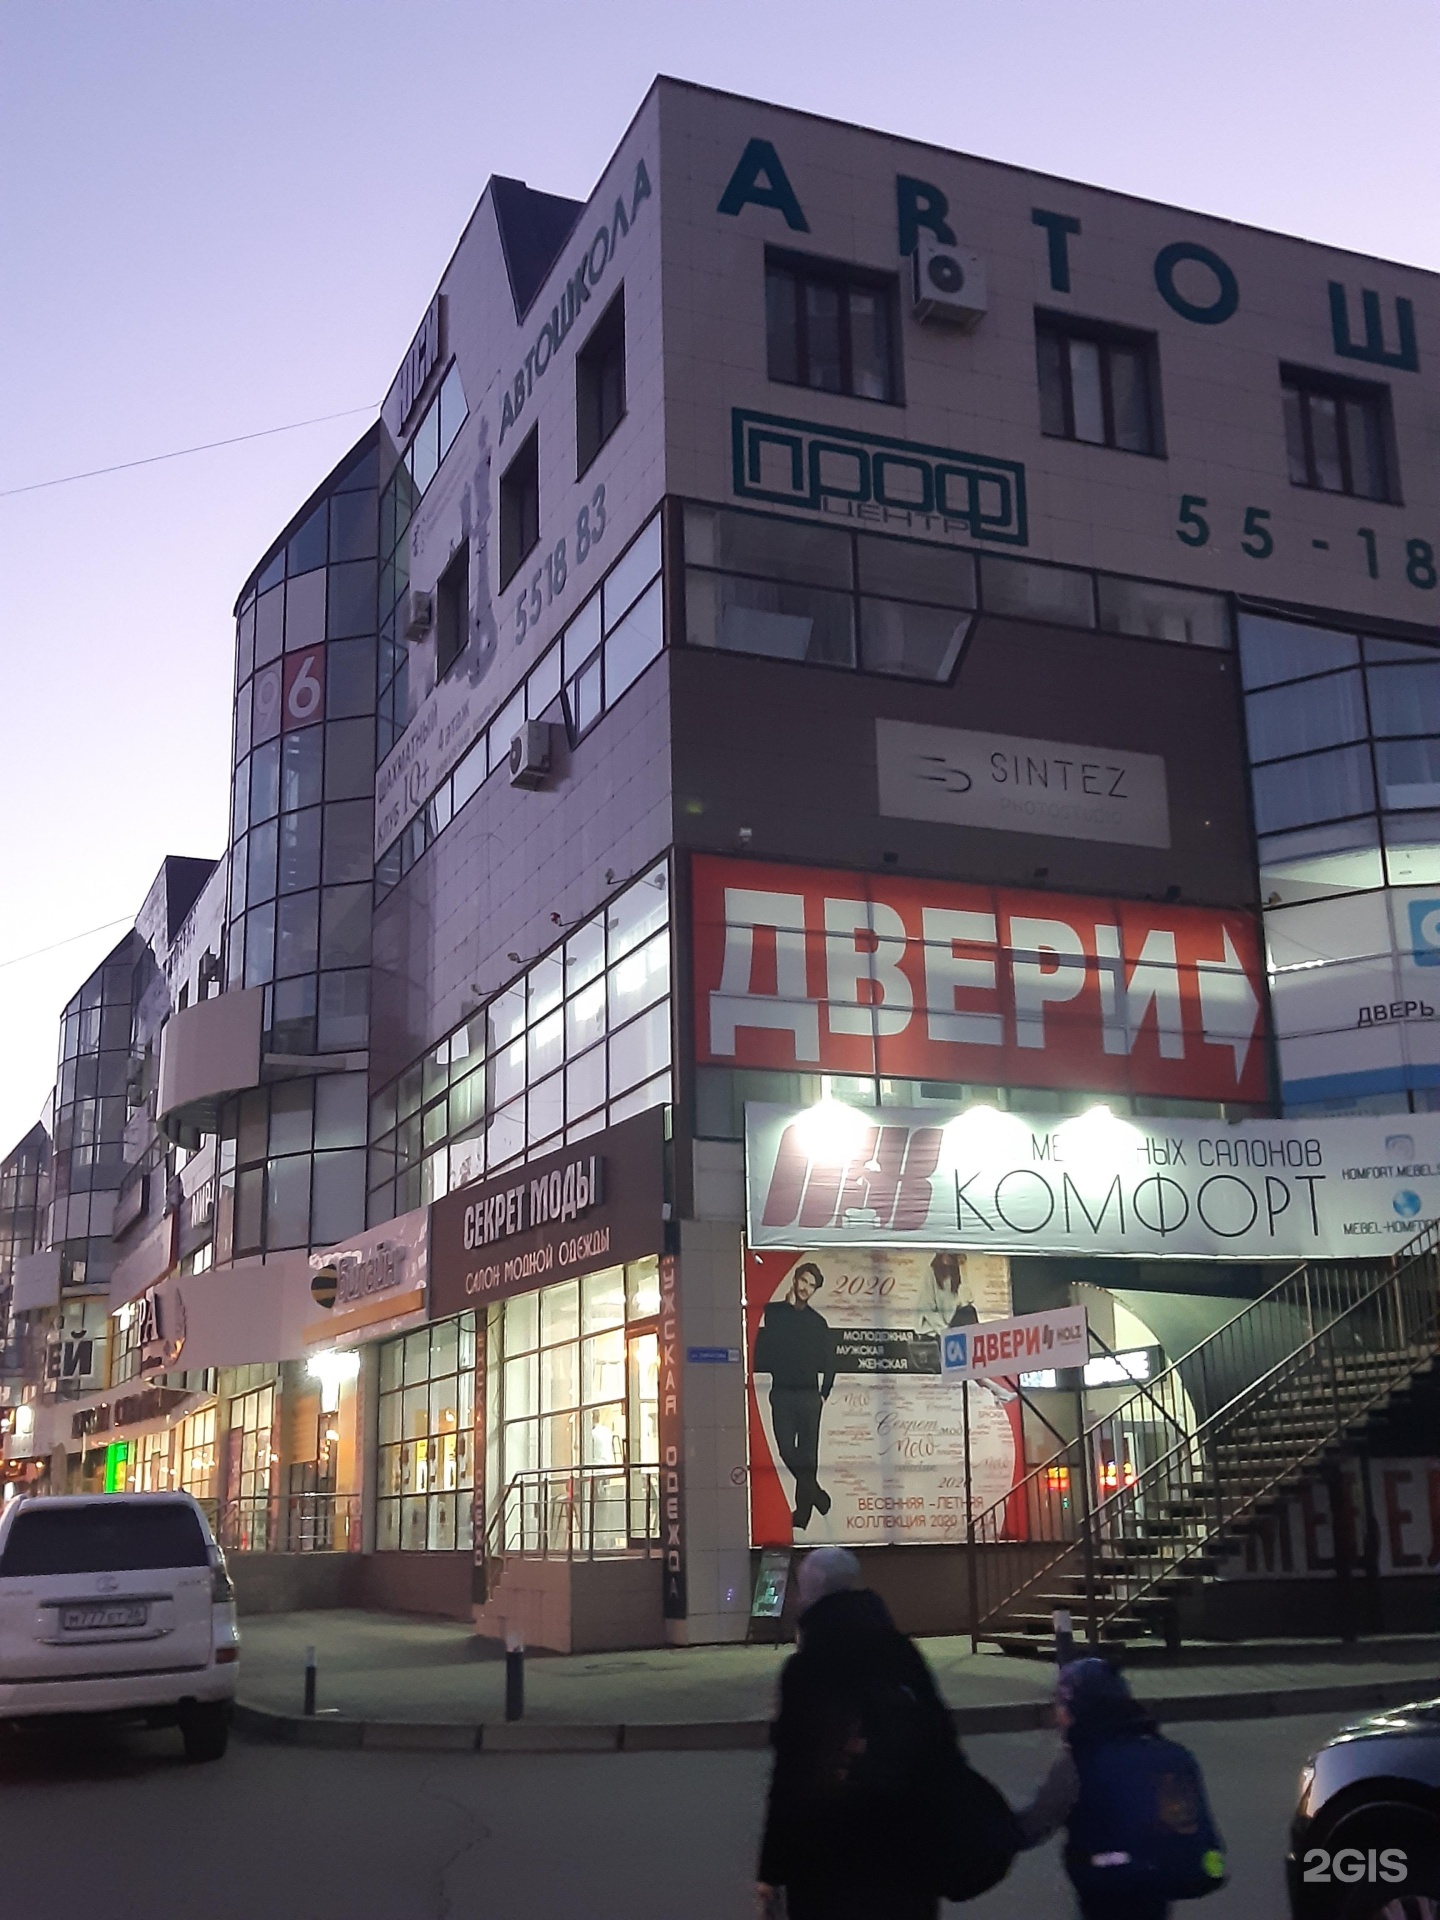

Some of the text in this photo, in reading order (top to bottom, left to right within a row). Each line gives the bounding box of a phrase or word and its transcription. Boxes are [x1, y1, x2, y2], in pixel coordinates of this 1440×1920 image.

[499, 158, 652, 446] АВТОШКОЛА
[749, 427, 1013, 537] ПРОФ
[821, 497, 970, 534] ЦЕНТР
[990, 752, 1128, 798] SINTEZ
[708, 888, 1186, 1064] ДВЕРИ
[1358, 1001, 1435, 1028] ДВЕРЬ
[1031, 1133, 1323, 1168] МЕНЫХ САЛОНОВ
[463, 1155, 596, 1250] СЕКРЕТ МОДЫ
[954, 1168, 1327, 1237] КОМФОРТ
[465, 1227, 610, 1295] САЛОН МОДНОЙ ОДЕЖДЫ
[832, 1274, 896, 1296] 2020
[836, 1345, 885, 1355] МУЖСКАЯ
[858, 1358, 908, 1369] ЖЕНСКАЯ
[972, 1325, 1040, 1369] ДВЕРИ
[938, 1476, 965, 1488] 202
[665, 1445, 681, 1600] ОДЕЖДА
[846, 1515, 926, 1529] КОЛЛЕКЦИЯ
[931, 1514, 957, 1527] 2020
[858, 1497, 924, 1510] ВЕСЕННЯЯ
